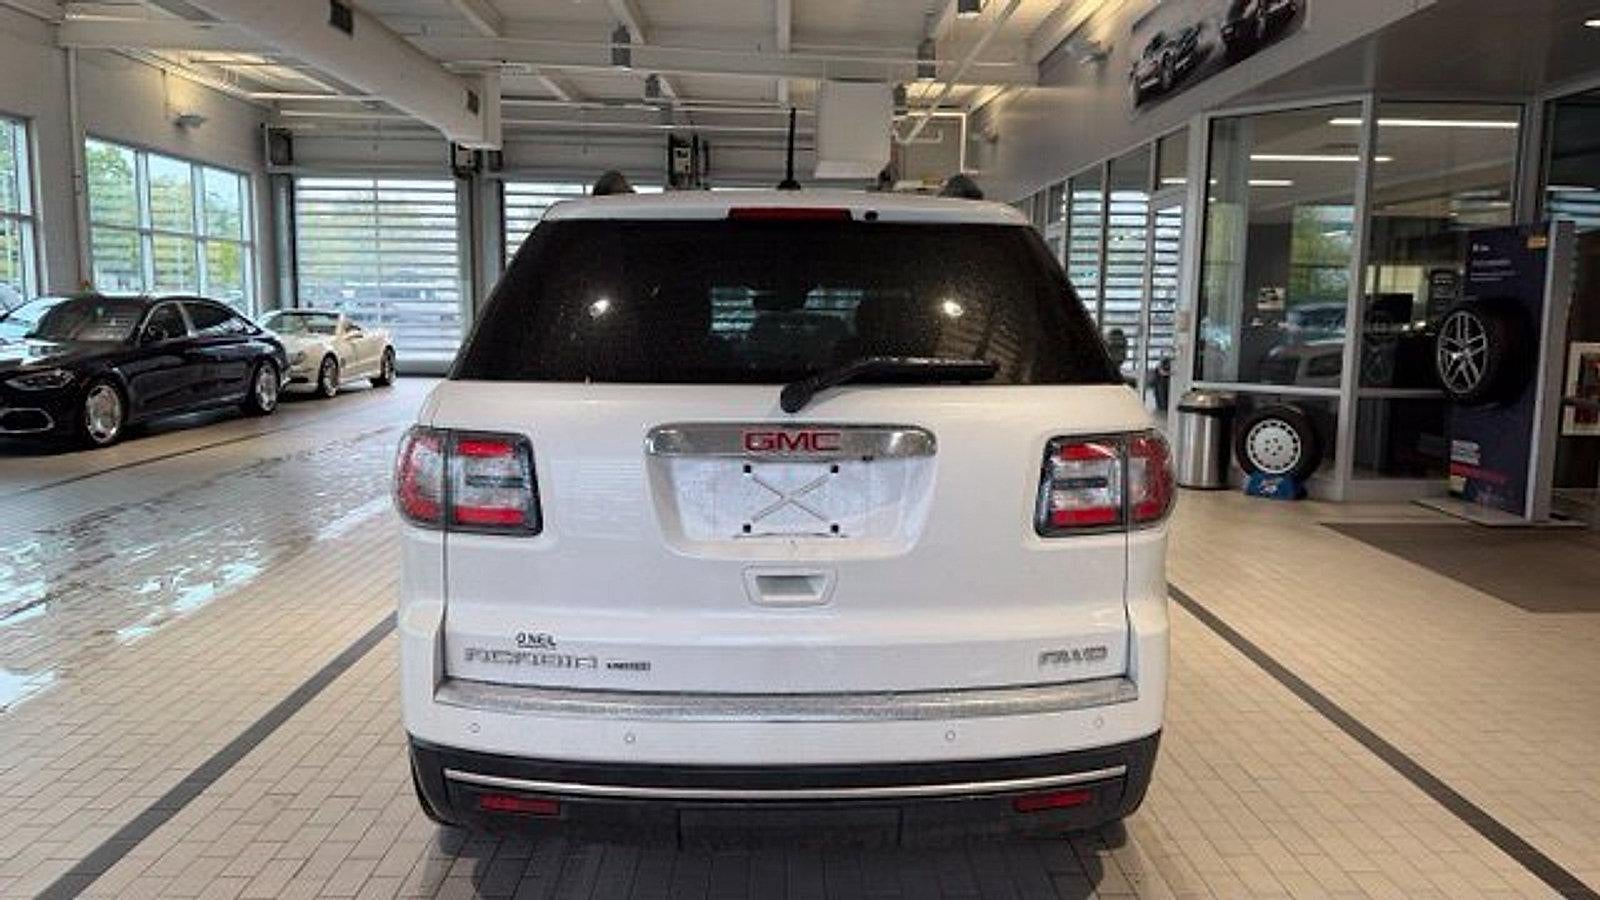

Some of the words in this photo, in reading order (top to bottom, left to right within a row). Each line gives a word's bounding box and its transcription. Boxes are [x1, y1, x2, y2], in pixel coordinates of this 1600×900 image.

[743, 430, 841, 452] GMC
[463, 648, 599, 670] ACADIA
[1038, 645, 1107, 665] AWD
